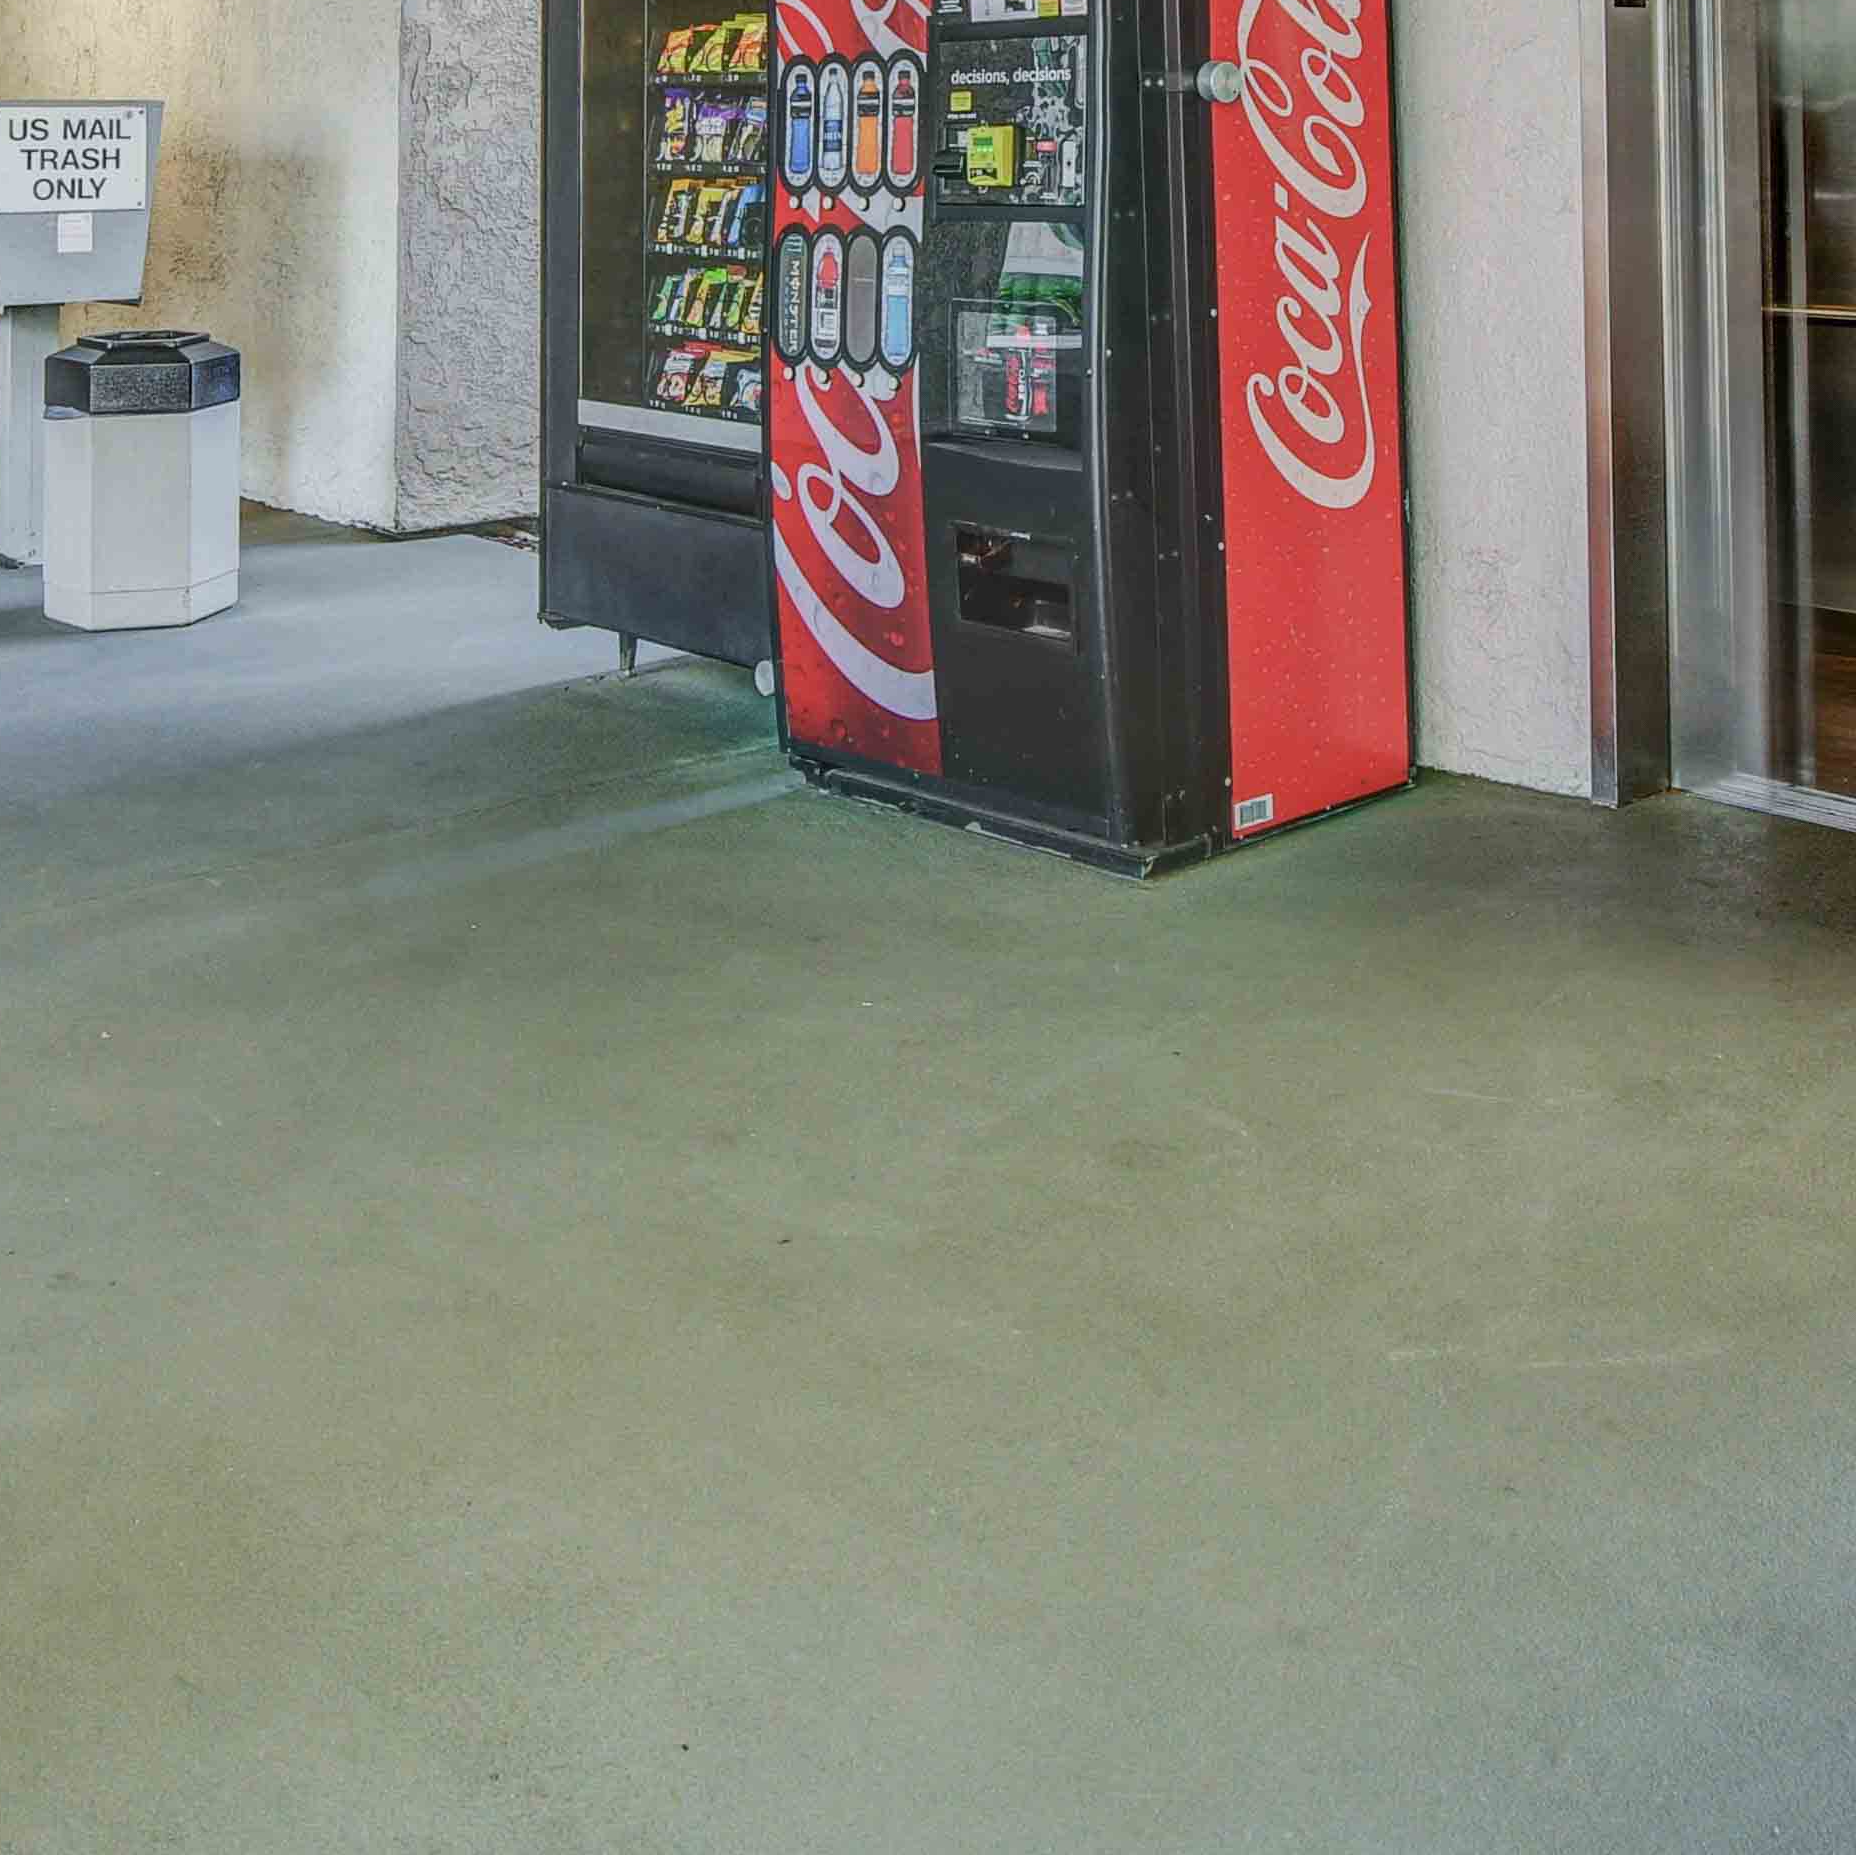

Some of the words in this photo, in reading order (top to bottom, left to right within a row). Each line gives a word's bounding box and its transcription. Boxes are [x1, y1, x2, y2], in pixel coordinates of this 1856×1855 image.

[950, 68, 1010, 85] decisions,
[1012, 66, 1072, 82] decisions
[9, 118, 49, 141] US
[62, 118, 131, 141] MAIL
[20, 147, 120, 171] TRASH
[32, 177, 107, 201] ONLY
[788, 259, 802, 354] MONSTER
